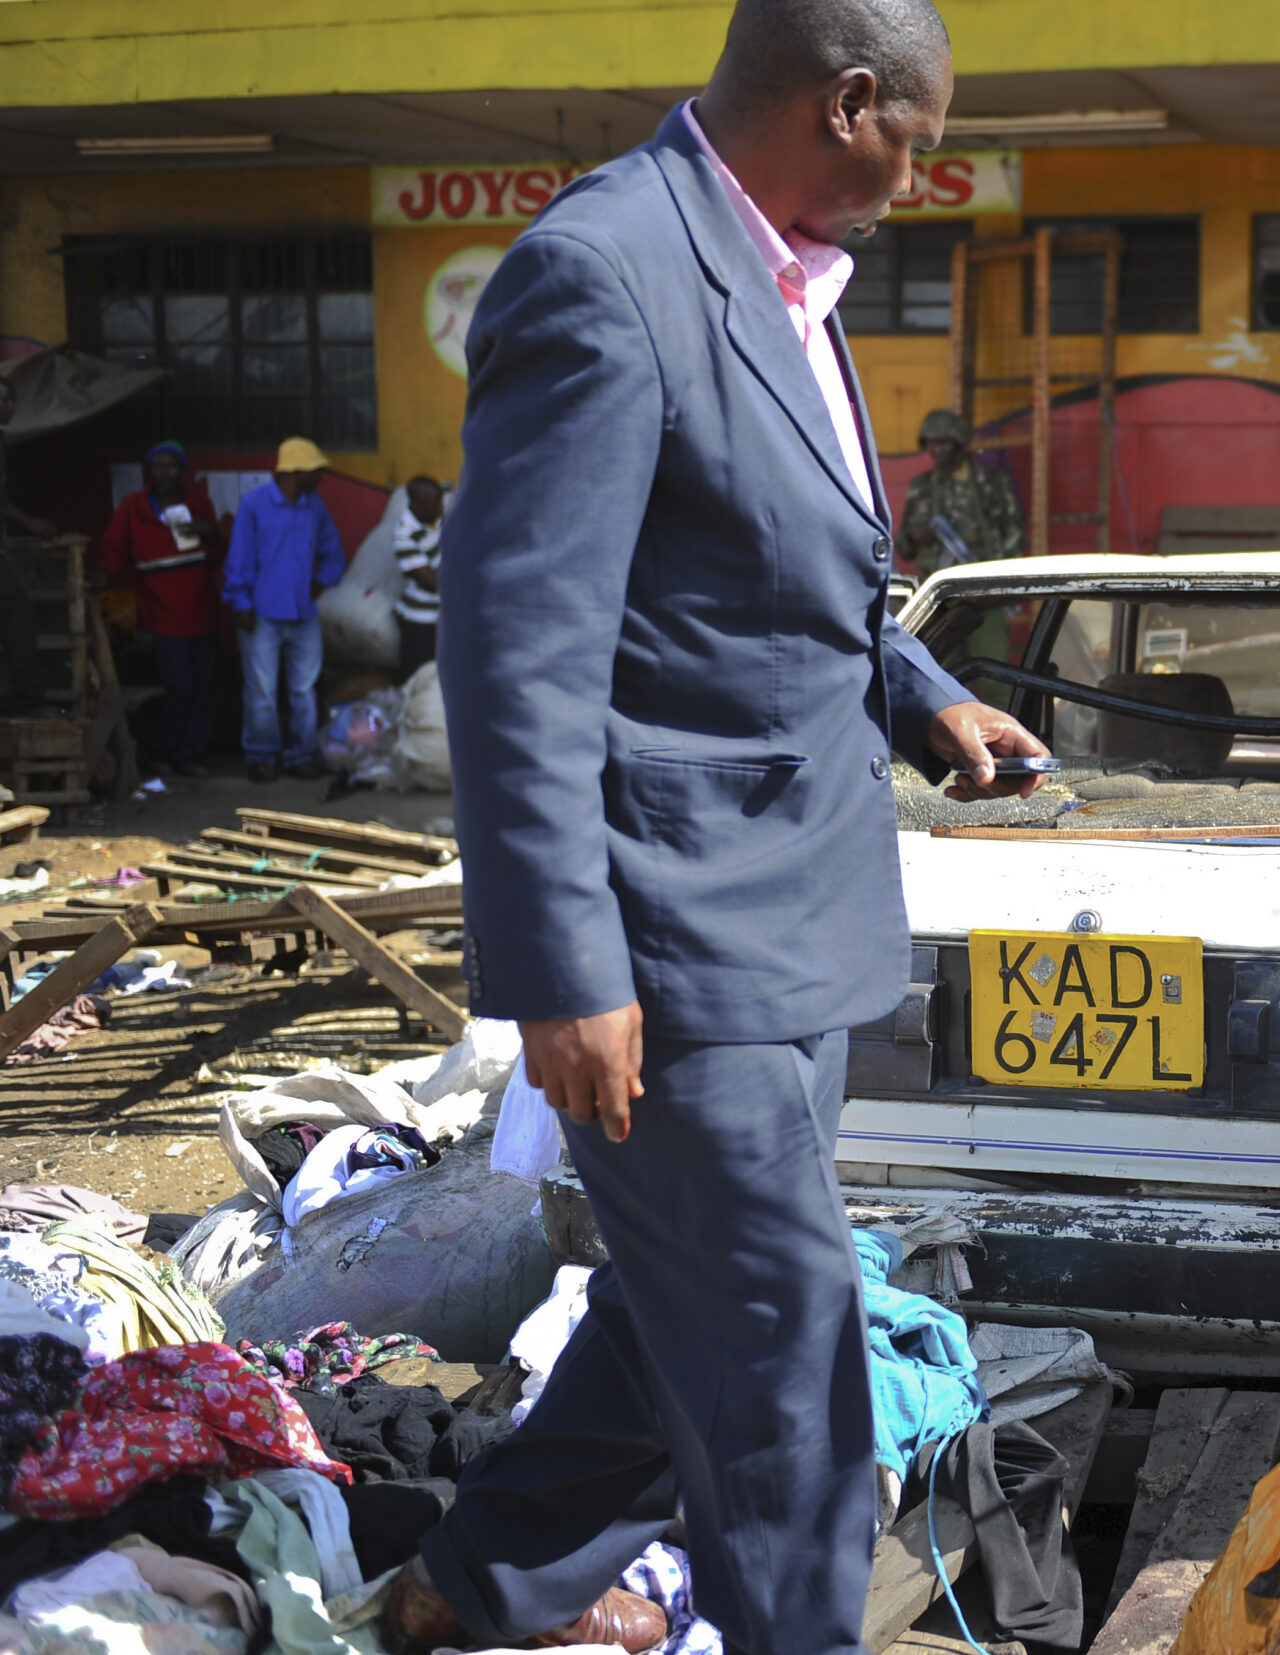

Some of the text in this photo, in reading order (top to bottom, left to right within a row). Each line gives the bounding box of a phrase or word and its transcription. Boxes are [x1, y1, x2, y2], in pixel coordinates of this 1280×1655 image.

[398, 167, 577, 220] JOYS
[999, 940, 1153, 1009] KAD
[994, 1010, 1193, 1081] 647L
